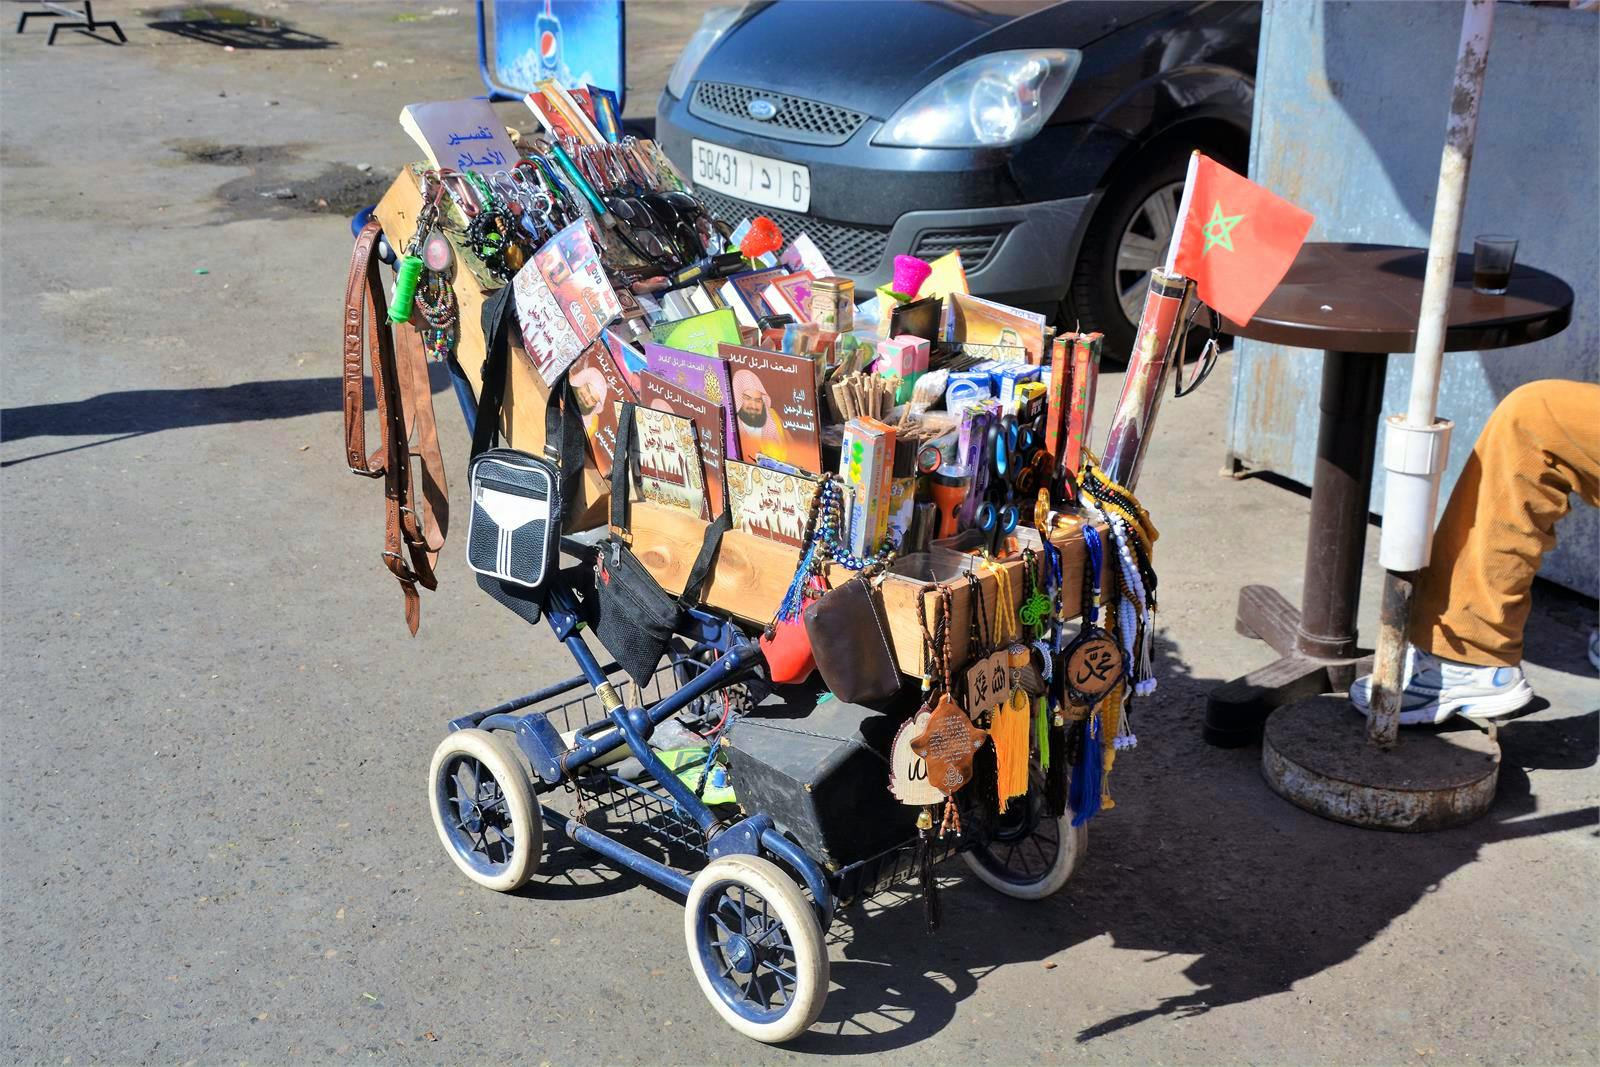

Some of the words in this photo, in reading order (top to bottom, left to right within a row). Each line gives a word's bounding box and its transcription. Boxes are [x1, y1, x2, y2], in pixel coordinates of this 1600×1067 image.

[447, 126, 494, 145] تفسير
[698, 146, 738, 187] 58431
[792, 170, 802, 203] 6
[783, 404, 803, 417] الرحمن
[803, 408, 814, 419] عبد
[783, 420, 815, 433] السديس
